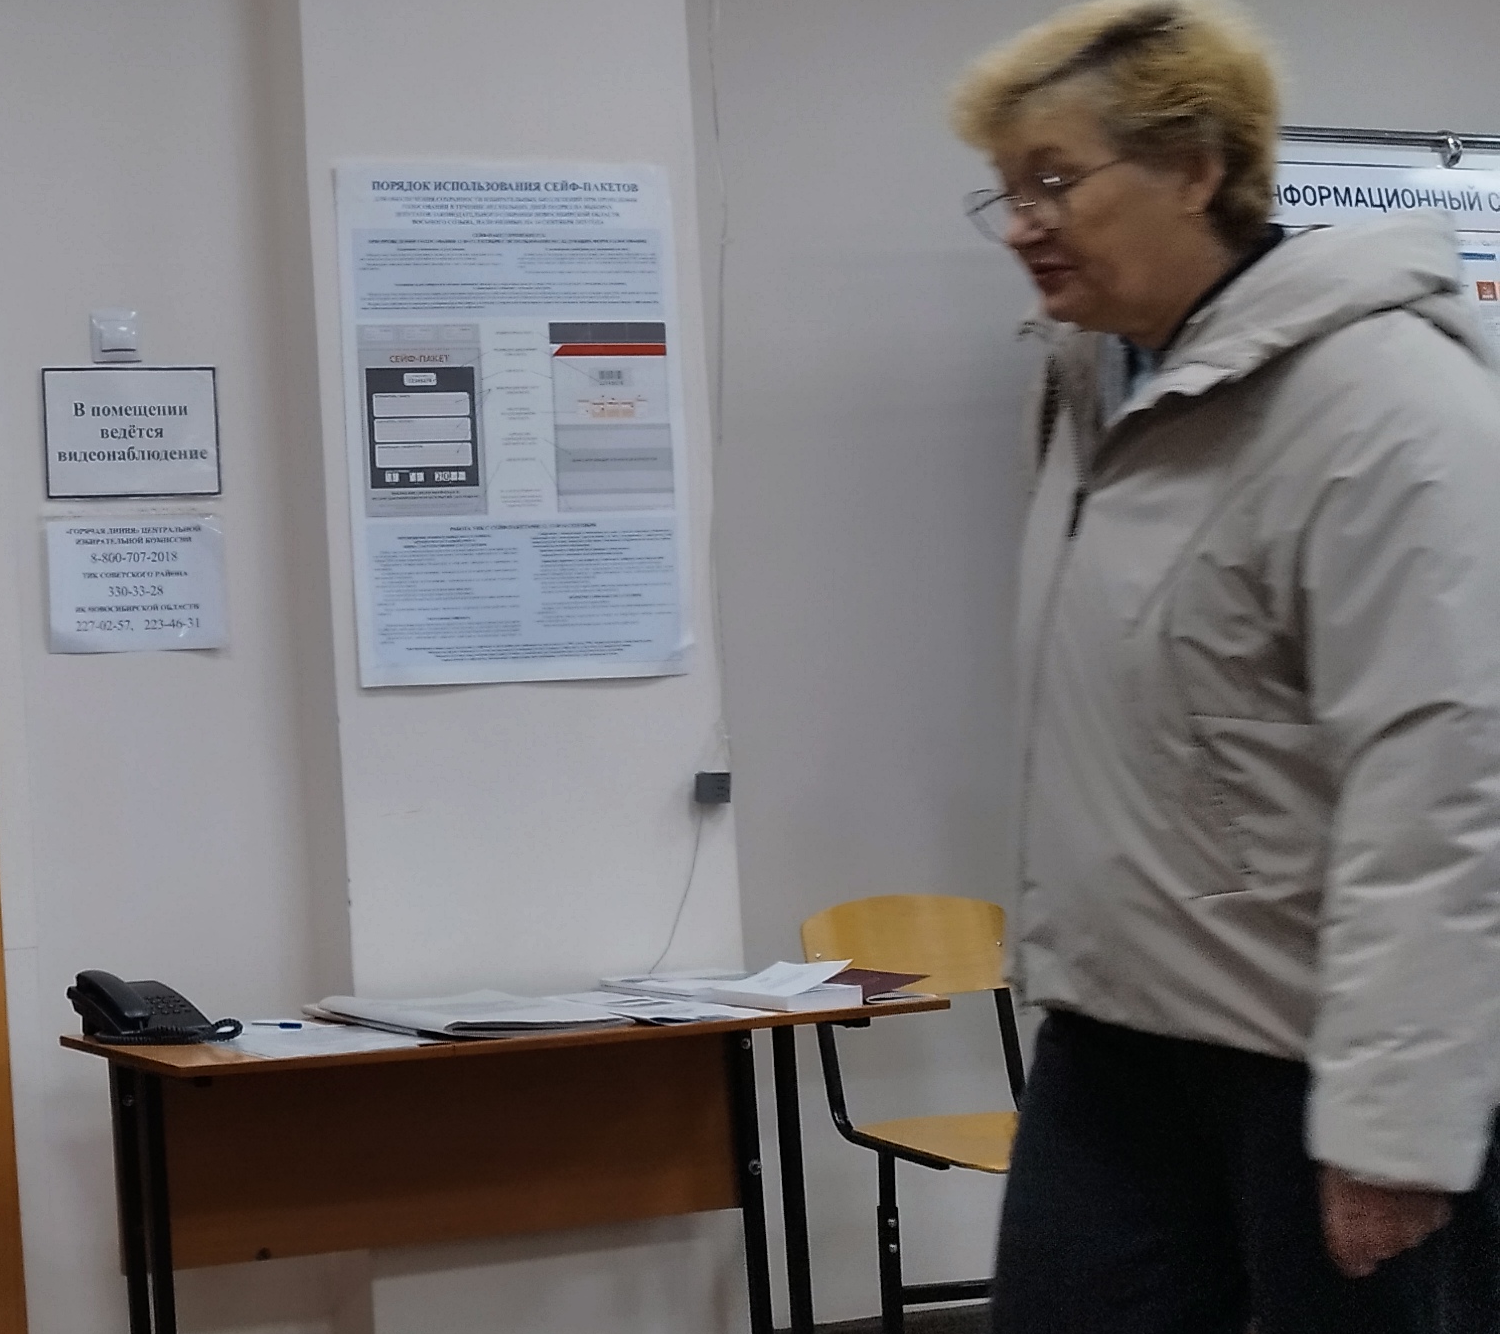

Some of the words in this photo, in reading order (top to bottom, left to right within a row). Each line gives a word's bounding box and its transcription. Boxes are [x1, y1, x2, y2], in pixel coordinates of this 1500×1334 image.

[371, 180, 431, 192] ПОРЯДОК
[434, 180, 541, 192] ИСПОЛЬЗОВАНИЯ
[544, 180, 639, 192] СЕЙФ-ПАКЕТОВ
[1273, 184, 1483, 213] НФОРМАЦИОННЫЙ
[73, 402, 85, 417] В
[91, 404, 188, 417] помещении
[100, 425, 164, 439] ведётся
[57, 446, 208, 462] видеонаблюдение
[90, 551, 178, 564] 8-800-707-2018
[108, 585, 164, 597] 330-33-28
